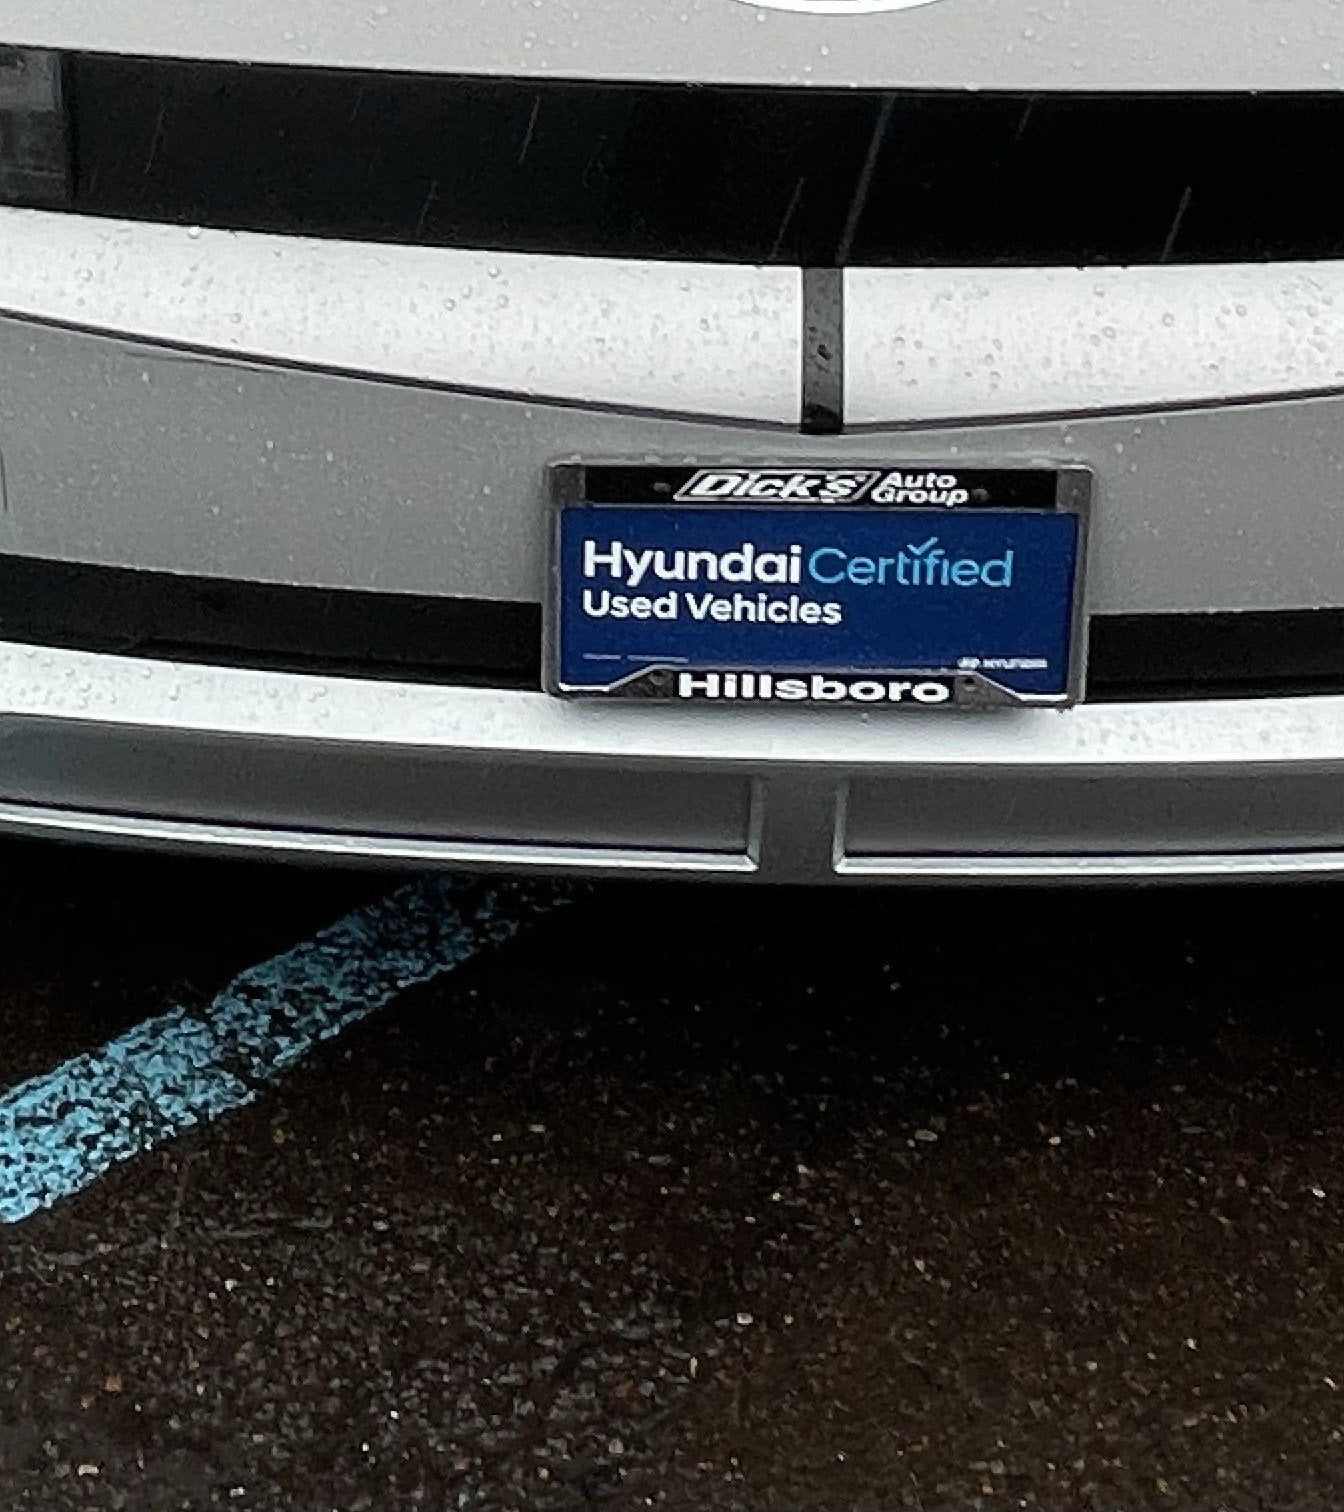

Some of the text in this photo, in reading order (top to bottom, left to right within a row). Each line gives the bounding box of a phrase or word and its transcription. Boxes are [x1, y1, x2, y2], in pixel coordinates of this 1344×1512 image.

[879, 471, 958, 489] Auto
[869, 487, 970, 508] Group
[583, 536, 1014, 588] Hyundai Certified
[582, 590, 843, 625] Used Vehicles
[677, 671, 951, 703] Hillsboro
